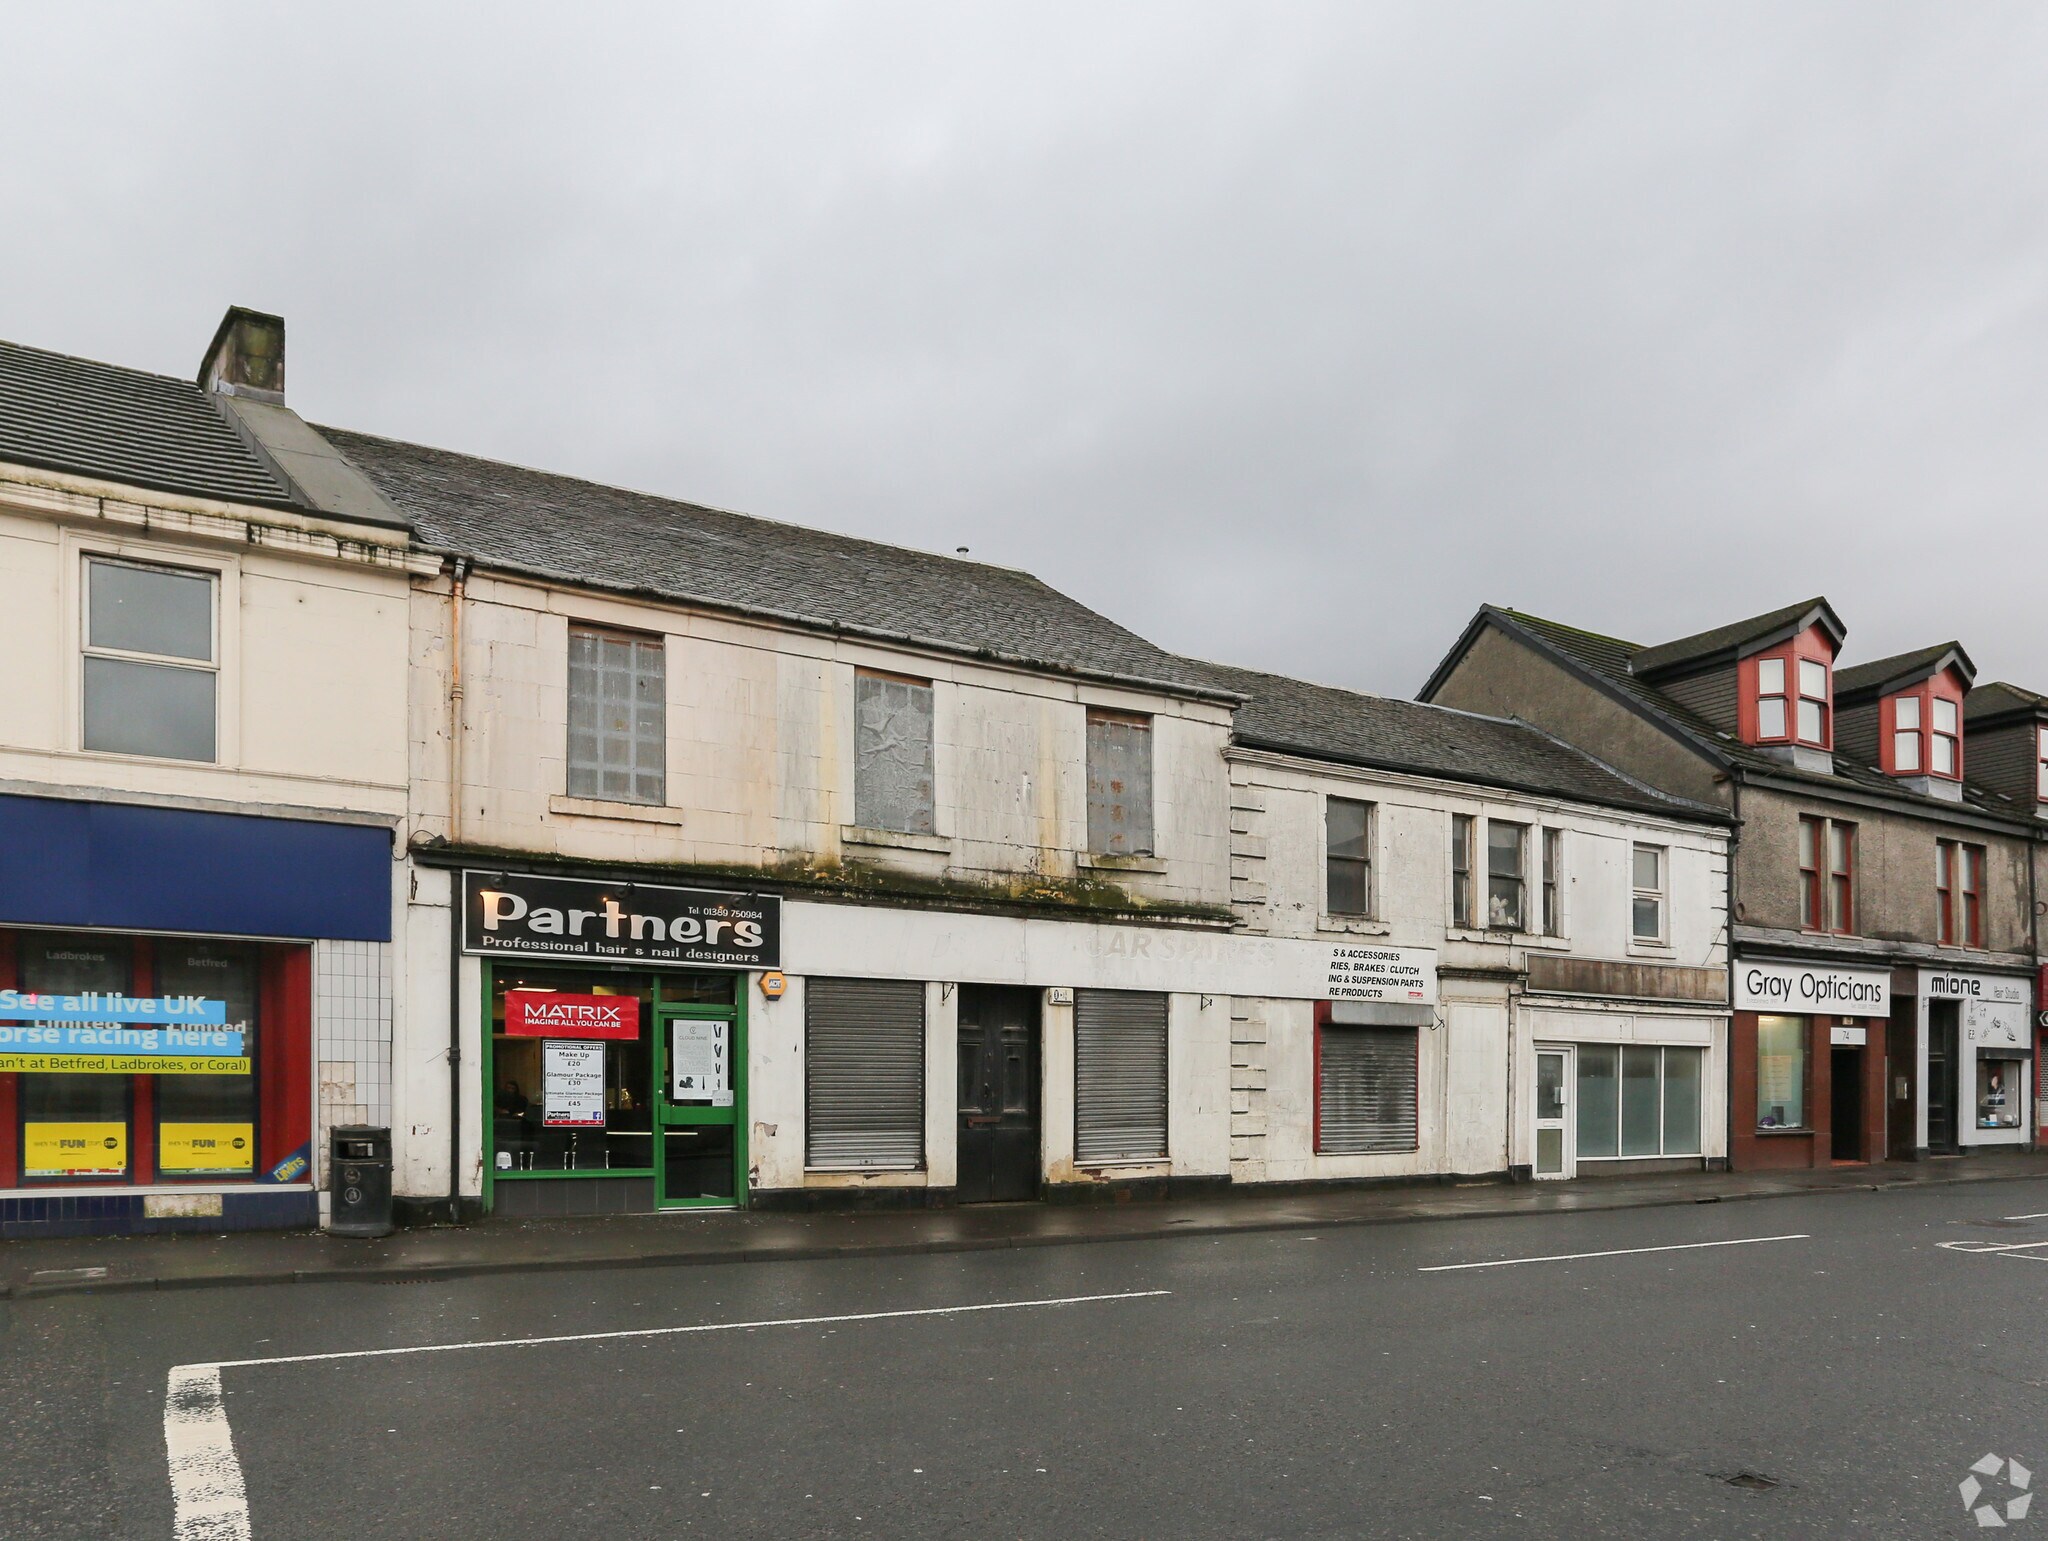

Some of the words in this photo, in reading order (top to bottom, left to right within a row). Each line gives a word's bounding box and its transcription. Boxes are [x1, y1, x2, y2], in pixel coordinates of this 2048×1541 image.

[480, 891, 764, 948] Partners
[703, 908, 728, 917] 01389
[730, 910, 763, 919] 750984
[482, 935, 588, 952] Professional
[595, 942, 628, 954] hair
[651, 948, 680, 958] nail
[685, 949, 760, 962] designers
[1340, 949, 1346, 957] &
[1347, 950, 1400, 961] ACCESSORIES
[46, 951, 105, 961] Ladbrokes
[187, 958, 228, 968] Betfred
[1330, 961, 1351, 972] RIES,
[1353, 963, 1386, 973] BRAKES
[1389, 965, 1420, 975] CLUTCH
[1328, 974, 1343, 983] ING
[1343, 975, 1350, 983] &
[1351, 975, 1399, 987] SUSPENSION
[1400, 978, 1424, 988] PARTS
[1747, 969, 1793, 1002] Gray
[1800, 972, 1882, 1004] Opticians
[1329, 987, 1340, 996] RE
[1341, 988, 1383, 998] PRODUCTS
[0, 989, 55, 1011] See
[62, 991, 98, 1012] all
[106, 992, 157, 1014] live
[163, 994, 206, 1015] UK
[524, 1003, 620, 1020] MATRIX
[525, 1018, 559, 1026] IMAGINE
[68, 1025, 159, 1050] racing
[166, 1025, 228, 1047] here
[1842, 1030, 1850, 1040] 74
[29, 1058, 45, 1069] at
[50, 1057, 109, 1071] Betfred,
[111, 1058, 187, 1072] Ladbrokes,
[190, 1061, 203, 1070] or
[207, 1060, 247, 1072] Coral)
[60, 1139, 86, 1149] FUN
[192, 1139, 216, 1148] FUN
